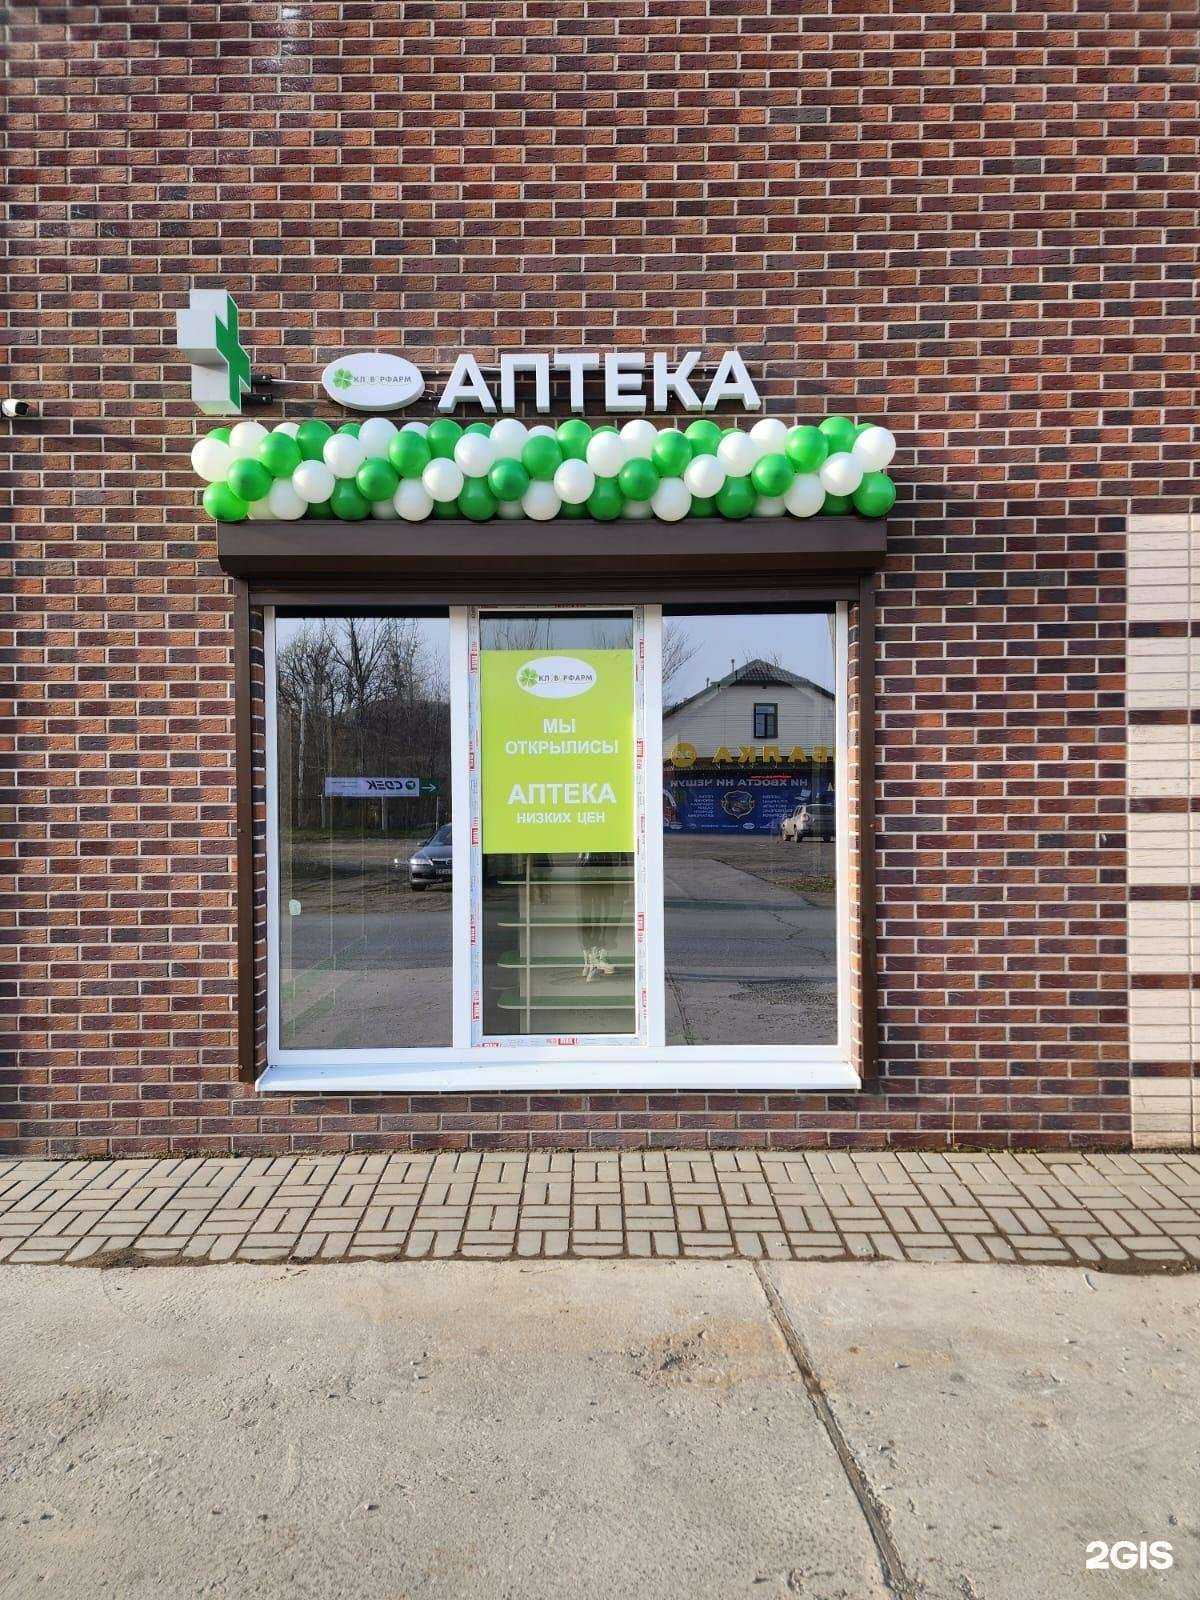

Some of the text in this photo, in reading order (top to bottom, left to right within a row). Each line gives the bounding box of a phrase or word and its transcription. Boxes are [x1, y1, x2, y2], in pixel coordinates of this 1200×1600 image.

[438, 350, 762, 414] АПТЕКА
[543, 718, 576, 734] МЫ
[507, 783, 617, 805] АПТЕКА
[517, 812, 605, 825] НИЗКИХ ЦЕН
